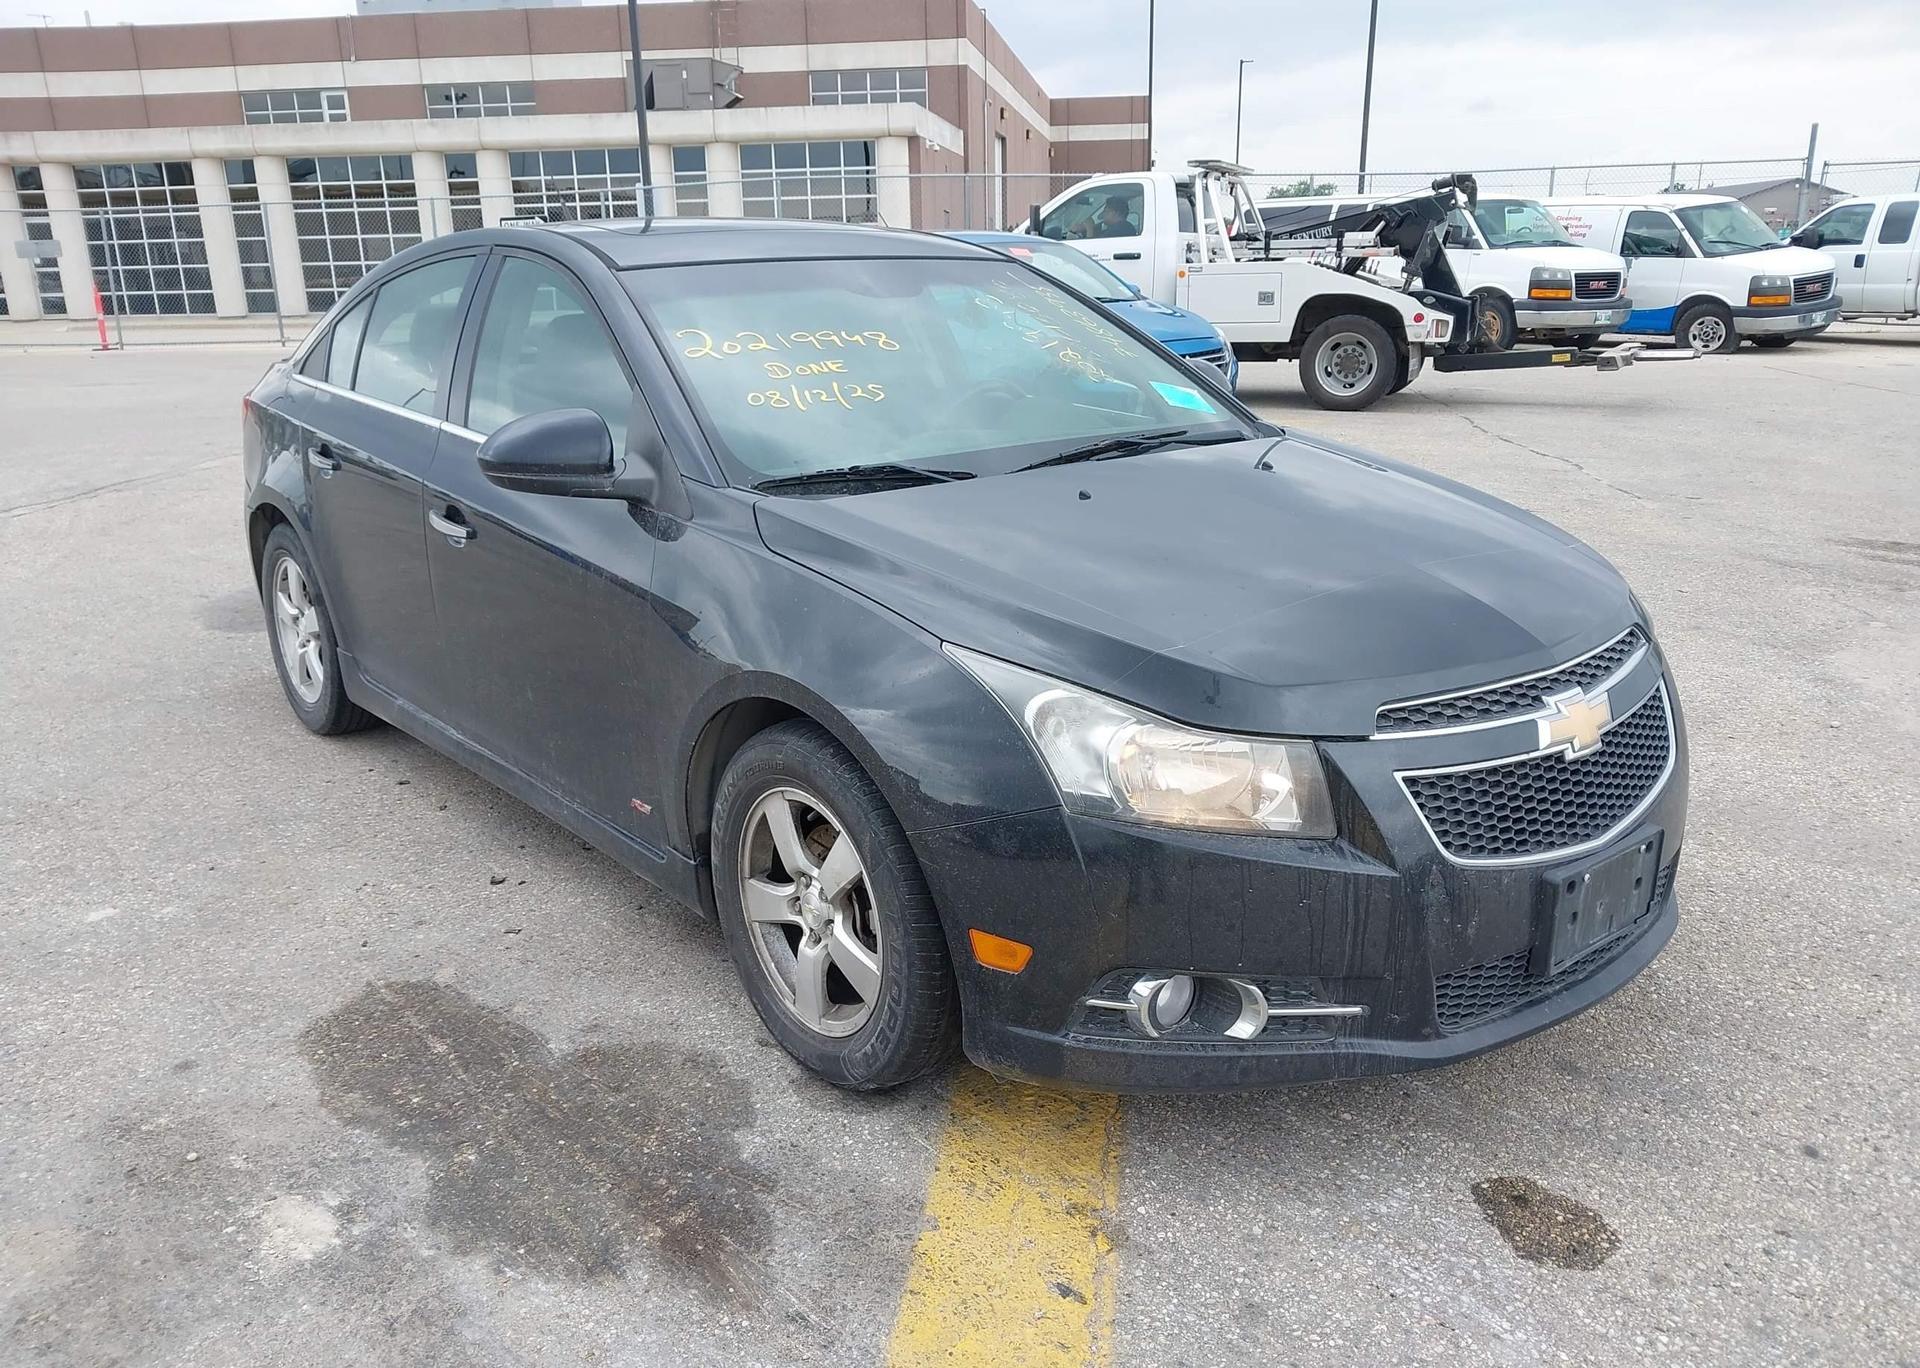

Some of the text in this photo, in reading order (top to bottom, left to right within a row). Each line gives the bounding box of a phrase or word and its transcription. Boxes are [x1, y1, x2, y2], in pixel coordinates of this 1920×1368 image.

[1291, 225, 1333, 240] CENTURY
[1590, 281, 1608, 289] GMC
[675, 329, 900, 359] 20219948
[764, 359, 848, 378] DONE
[747, 381, 885, 410] 08/12/25
